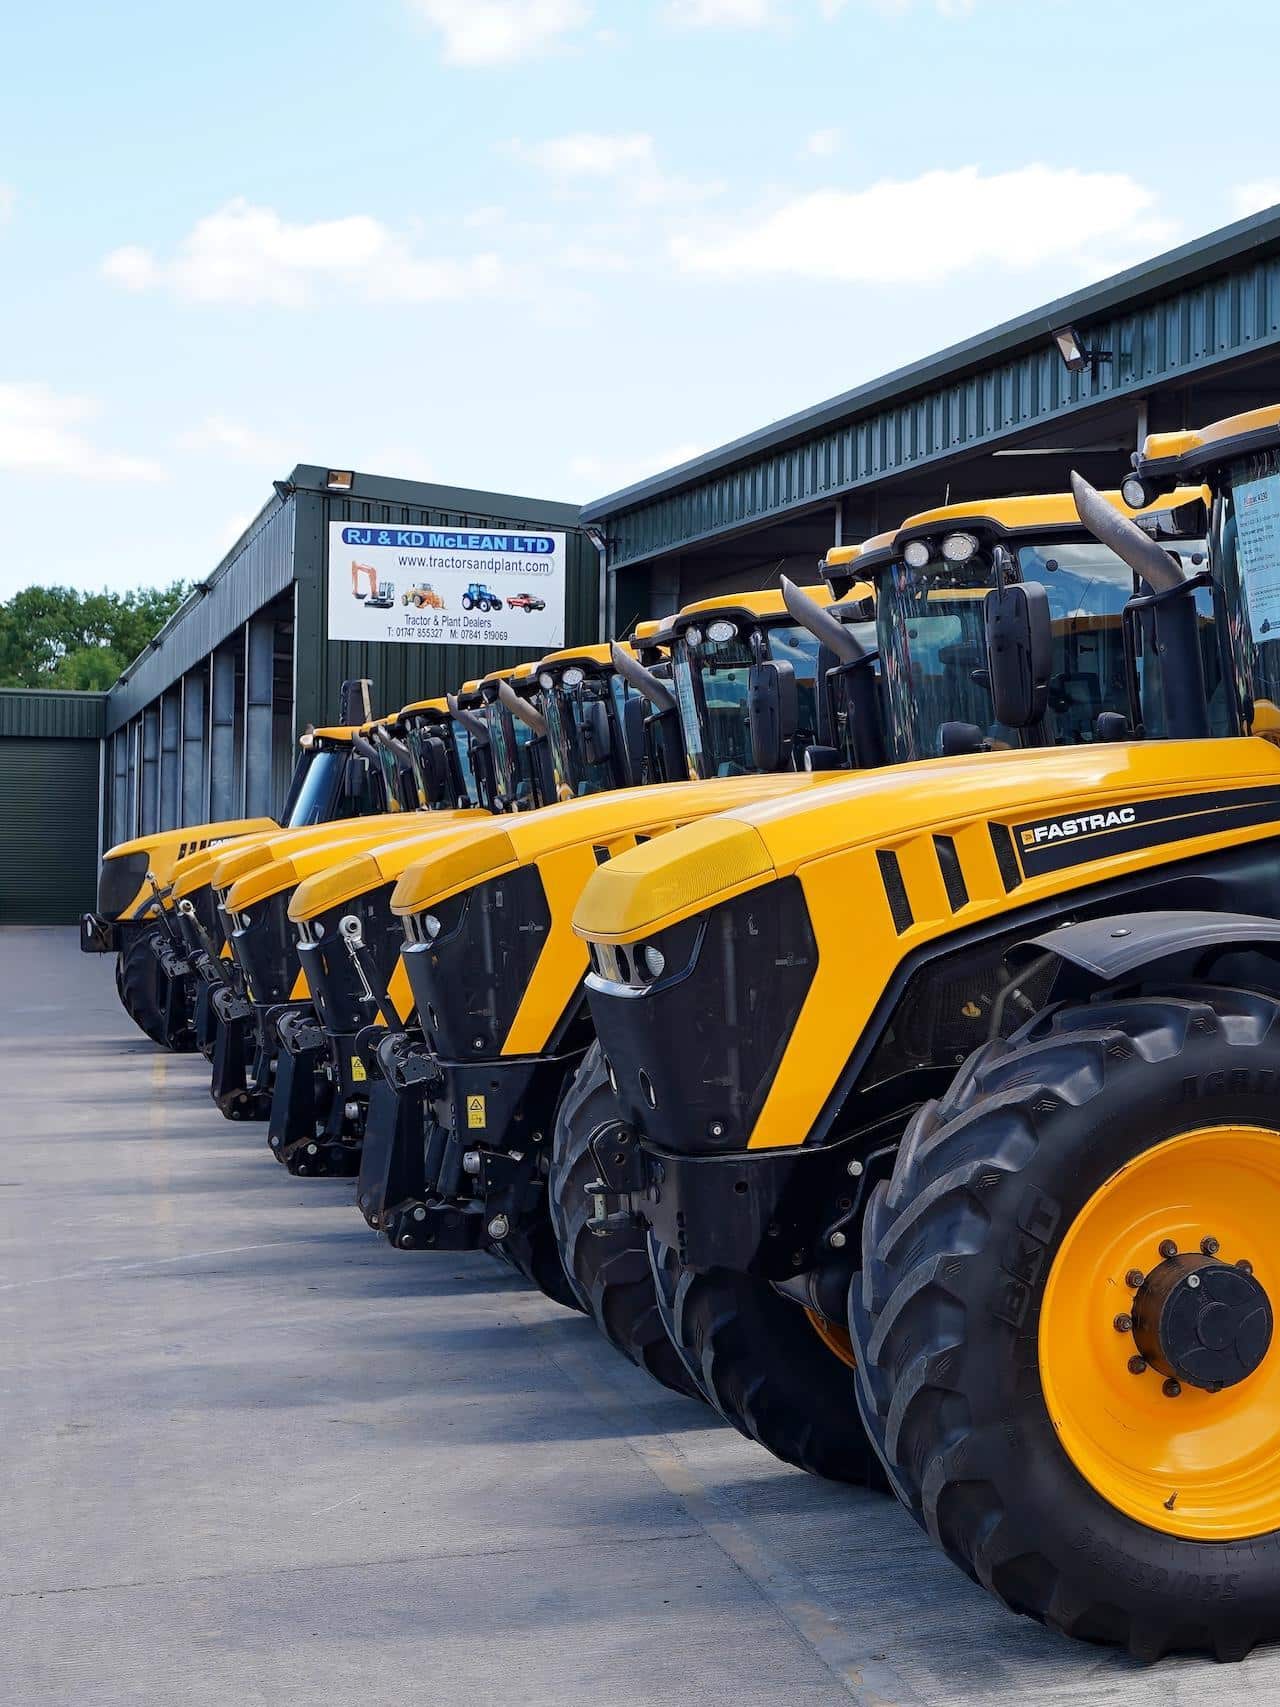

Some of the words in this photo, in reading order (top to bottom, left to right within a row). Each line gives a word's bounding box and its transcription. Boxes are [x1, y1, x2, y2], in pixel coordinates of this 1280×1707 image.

[347, 529, 371, 543] RJ
[378, 531, 391, 544] &
[398, 532, 424, 546] KD
[429, 534, 508, 551] McLEAN
[513, 537, 549, 553] LTD
[398, 555, 550, 574] www.tractorsandplant.com
[404, 614, 432, 626] Tractor
[433, 615, 440, 626] &
[441, 615, 461, 627] Plant
[463, 616, 492, 628] Dealers
[387, 627, 394, 637] T:
[396, 627, 415, 638] 01747
[417, 627, 443, 638] 855327
[450, 629, 459, 639] M:
[461, 629, 481, 640] 07841
[484, 630, 508, 641] 519069
[1033, 807, 1136, 843] FASTRAC
